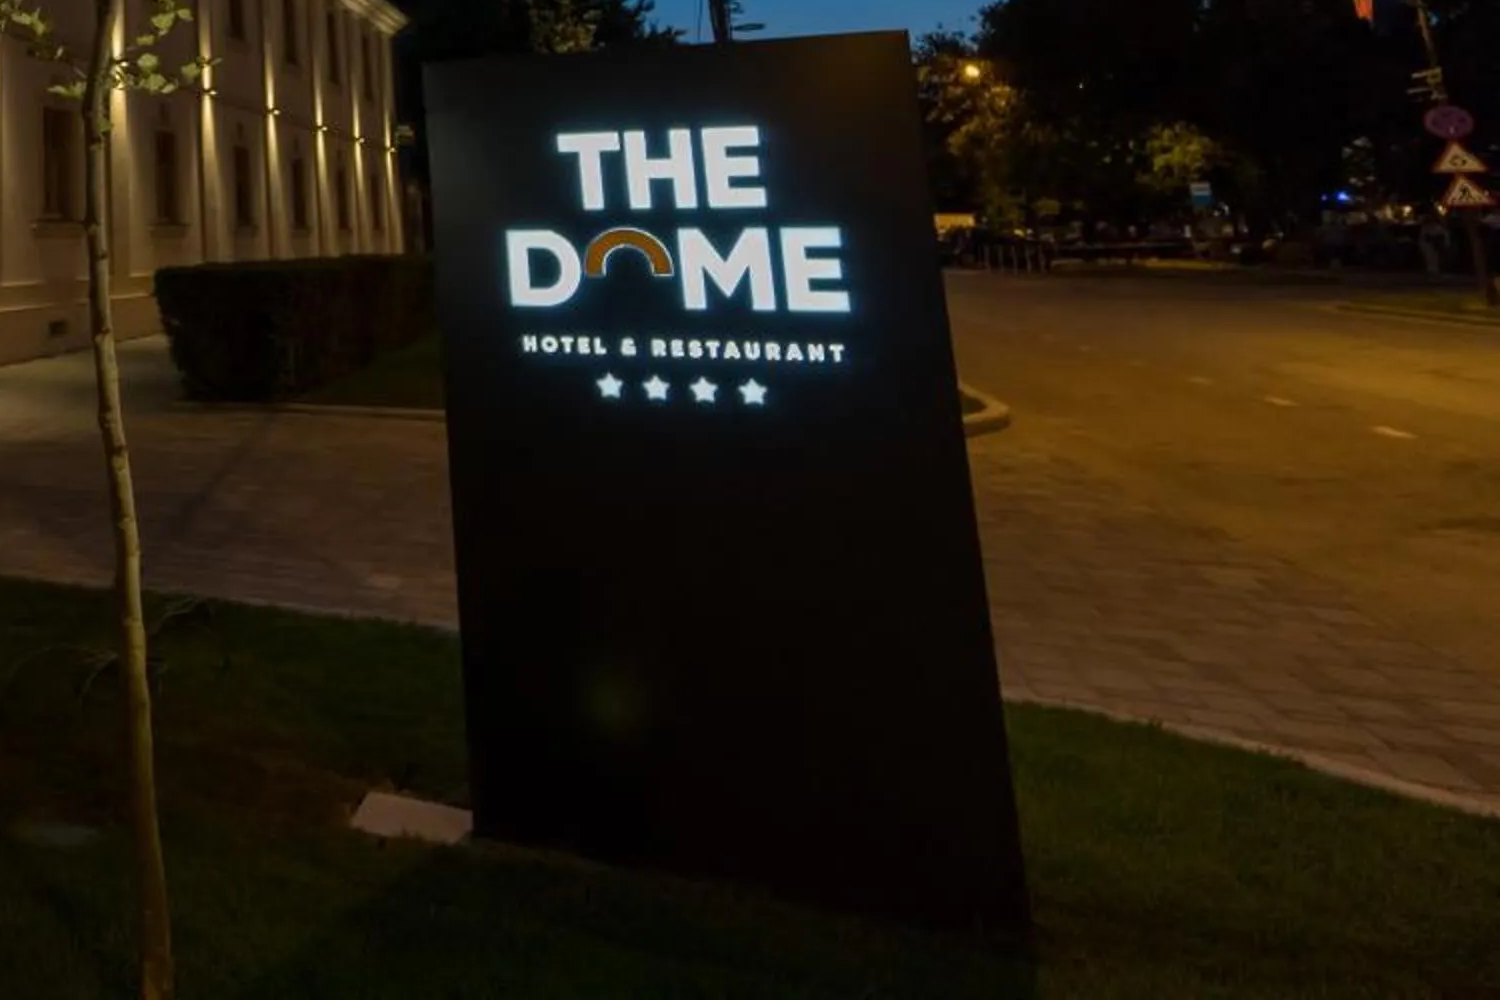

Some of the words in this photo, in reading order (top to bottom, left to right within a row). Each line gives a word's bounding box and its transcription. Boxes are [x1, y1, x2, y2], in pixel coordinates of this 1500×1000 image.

[555, 125, 768, 212] THE
[505, 225, 852, 313] DOME
[521, 334, 607, 356] HOTEL
[620, 338, 638, 357] &
[650, 338, 847, 364] RESTAURANT
